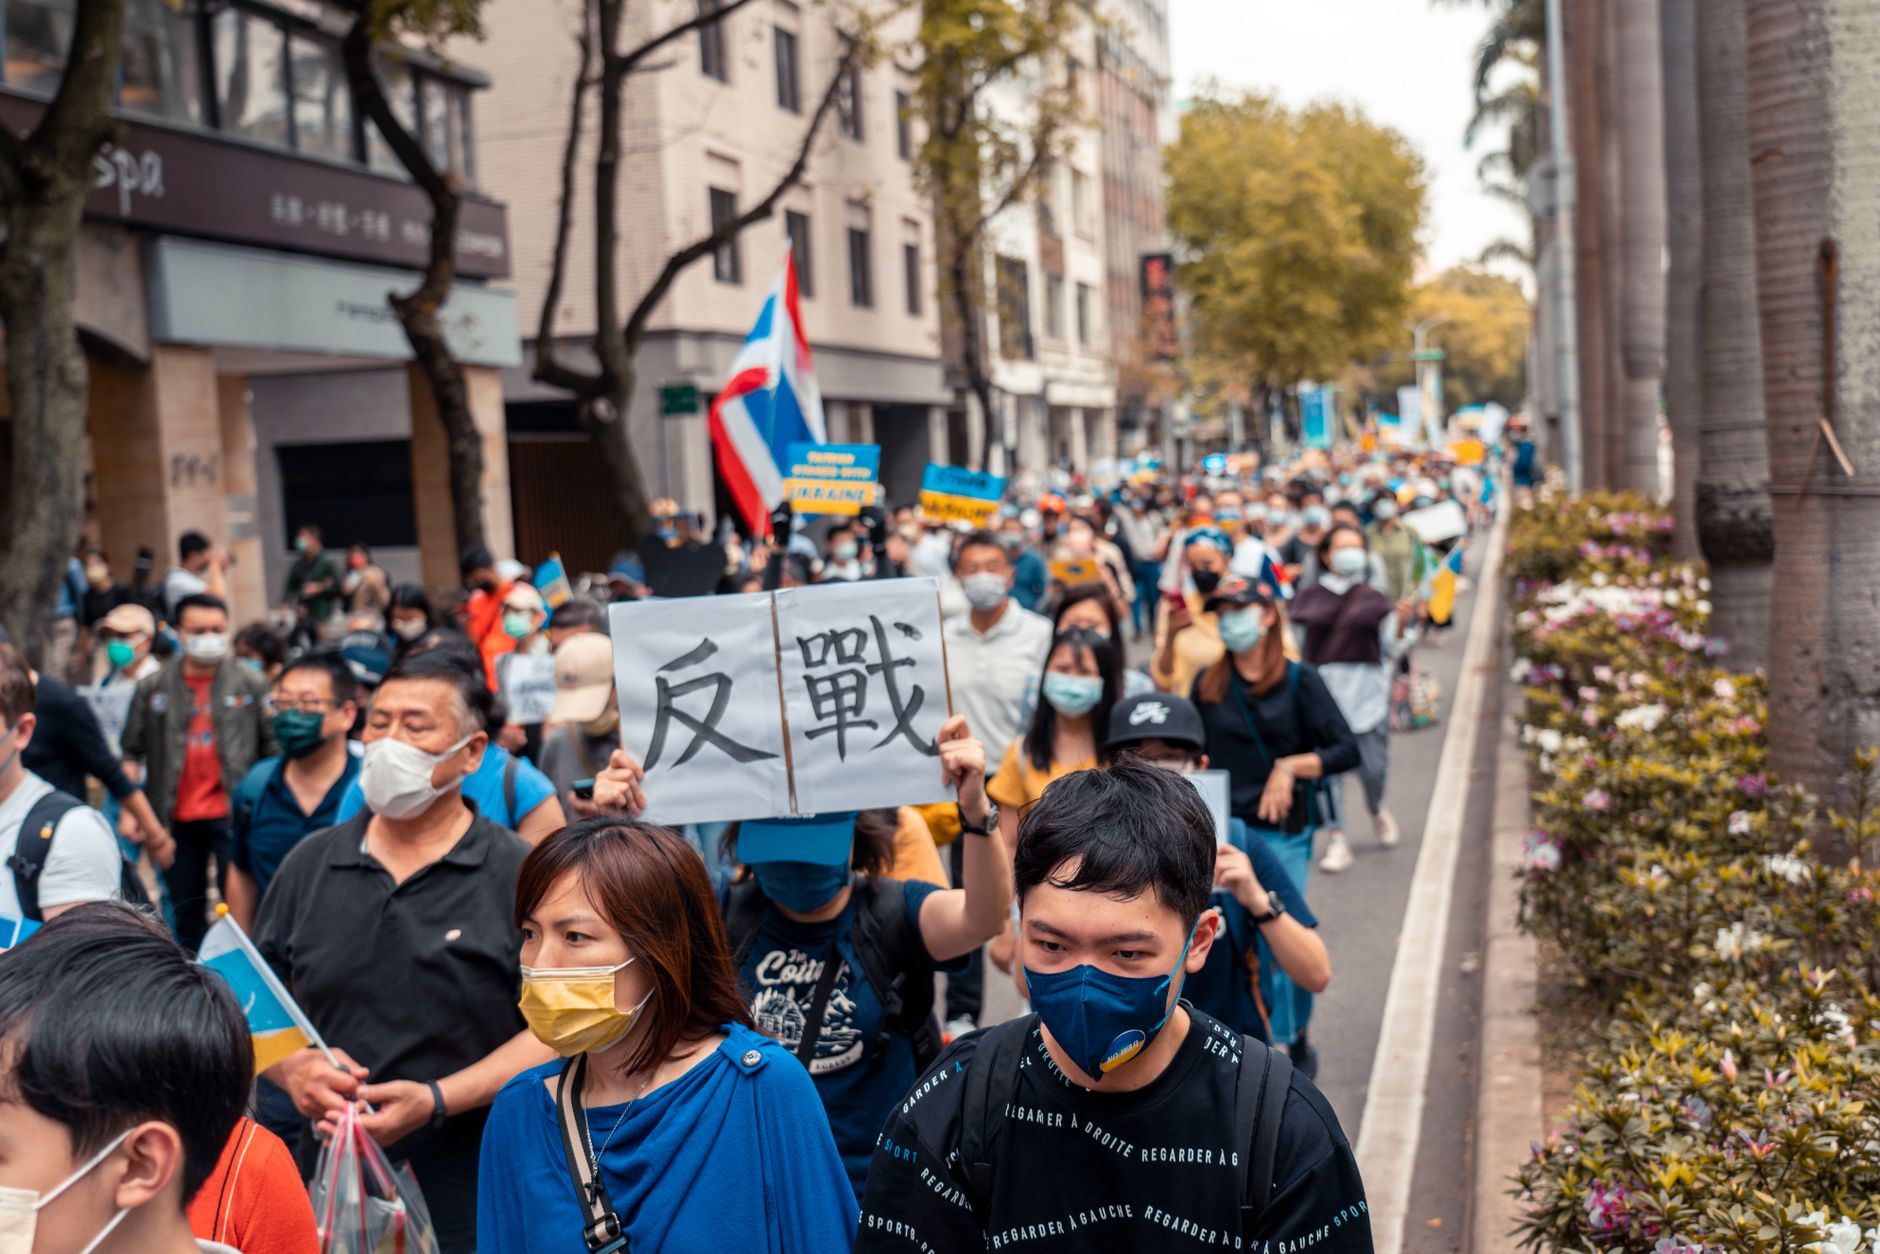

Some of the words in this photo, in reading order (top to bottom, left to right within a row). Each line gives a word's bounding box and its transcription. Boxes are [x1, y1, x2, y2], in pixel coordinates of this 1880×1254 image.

[643, 613, 940, 773] 反戰
[1084, 1121, 1134, 1158] DROITE
[1141, 1148, 1213, 1165] REGARDER
[992, 1221, 1065, 1249] REGARDER
[1079, 1203, 1134, 1226] GAUCHE
[1144, 1205, 1217, 1245] REGARDER
[1278, 1224, 1330, 1254] GAUCHE
